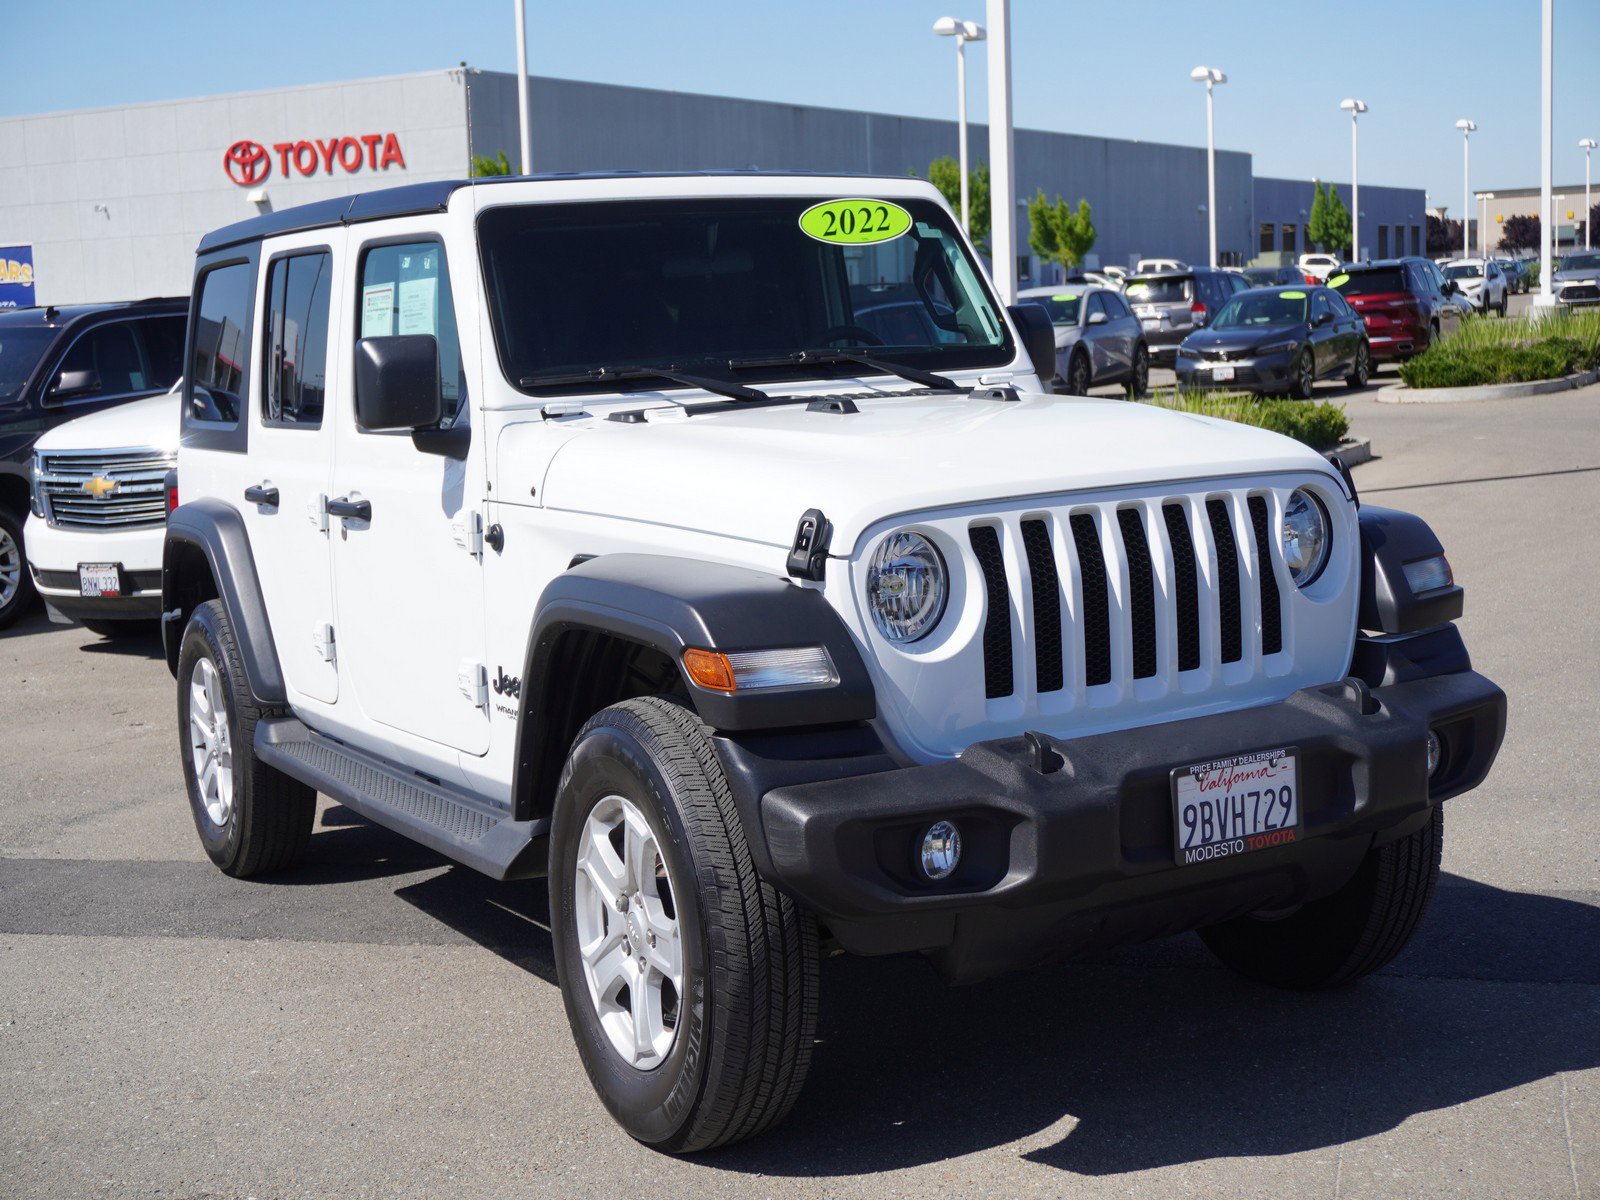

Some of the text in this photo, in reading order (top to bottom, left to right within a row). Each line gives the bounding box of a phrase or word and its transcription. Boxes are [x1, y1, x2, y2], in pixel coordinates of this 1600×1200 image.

[273, 133, 406, 177] TOYOTA
[821, 206, 891, 237] 2022
[492, 665, 521, 700] Jee
[496, 704, 520, 716] WRAN
[1190, 750, 1286, 774] PRICE FAMILY DEALERSHIPS
[1199, 766, 1277, 793] California
[1183, 785, 1292, 848] 9BVH729
[1185, 829, 1296, 864] MODESTO TOYOTA
